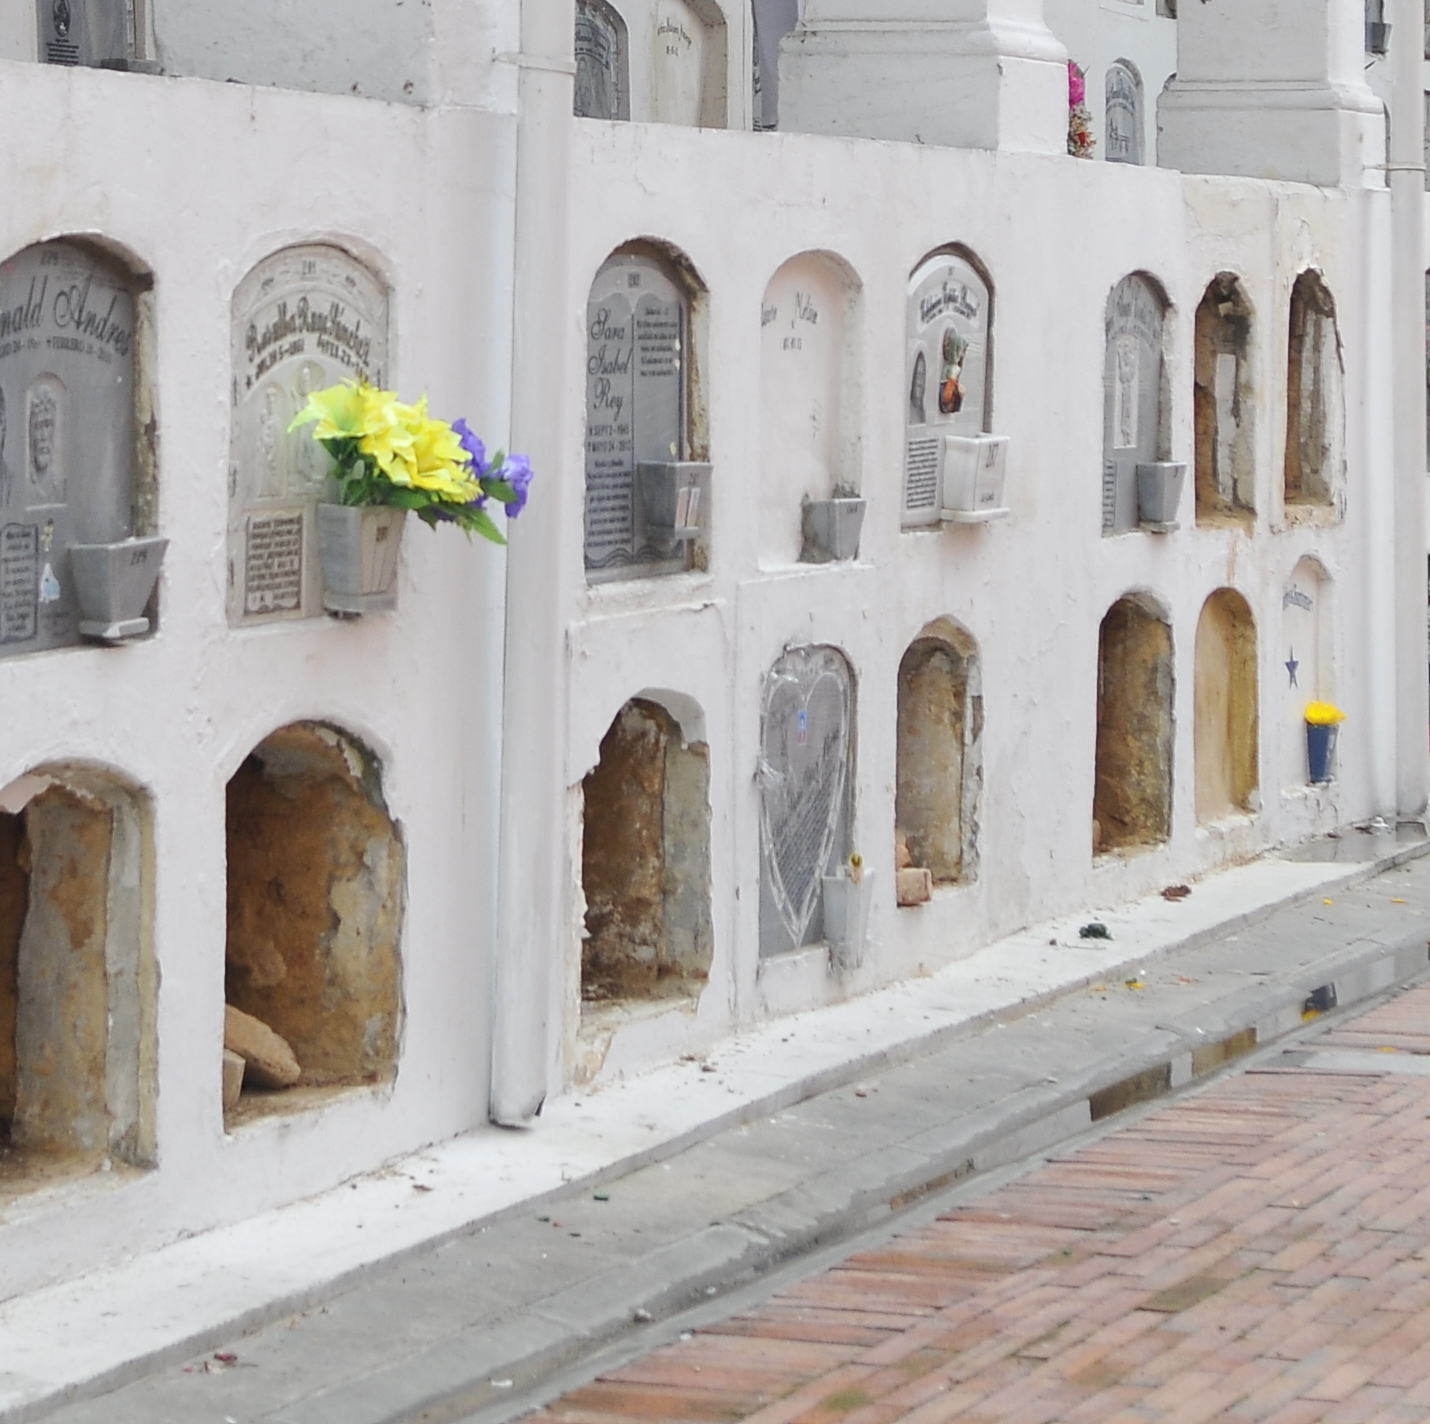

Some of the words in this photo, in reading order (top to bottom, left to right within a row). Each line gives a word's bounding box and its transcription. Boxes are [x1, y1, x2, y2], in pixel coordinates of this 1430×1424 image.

[590, 307, 625, 342] Sara
[587, 346, 632, 378] Isabel
[593, 377, 624, 422] Rey
